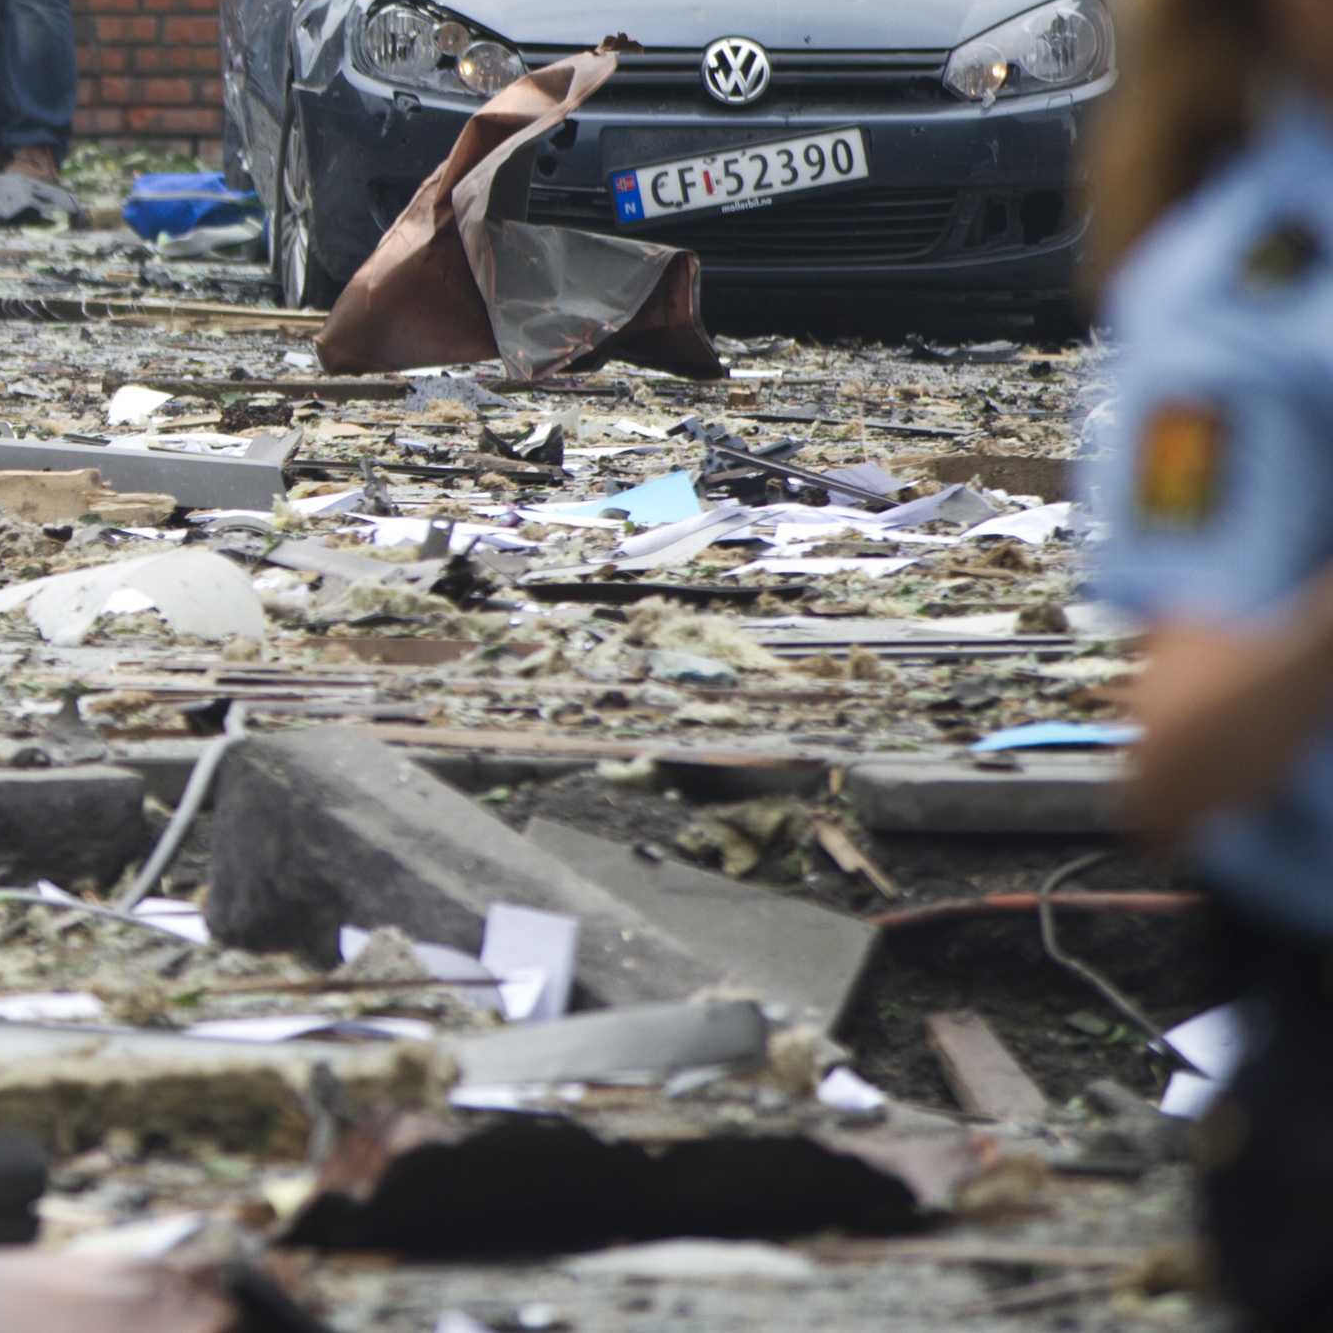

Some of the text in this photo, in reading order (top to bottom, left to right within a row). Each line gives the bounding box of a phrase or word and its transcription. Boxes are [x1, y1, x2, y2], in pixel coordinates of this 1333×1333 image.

[650, 138, 855, 209] CF 52390
[624, 201, 637, 215] N
